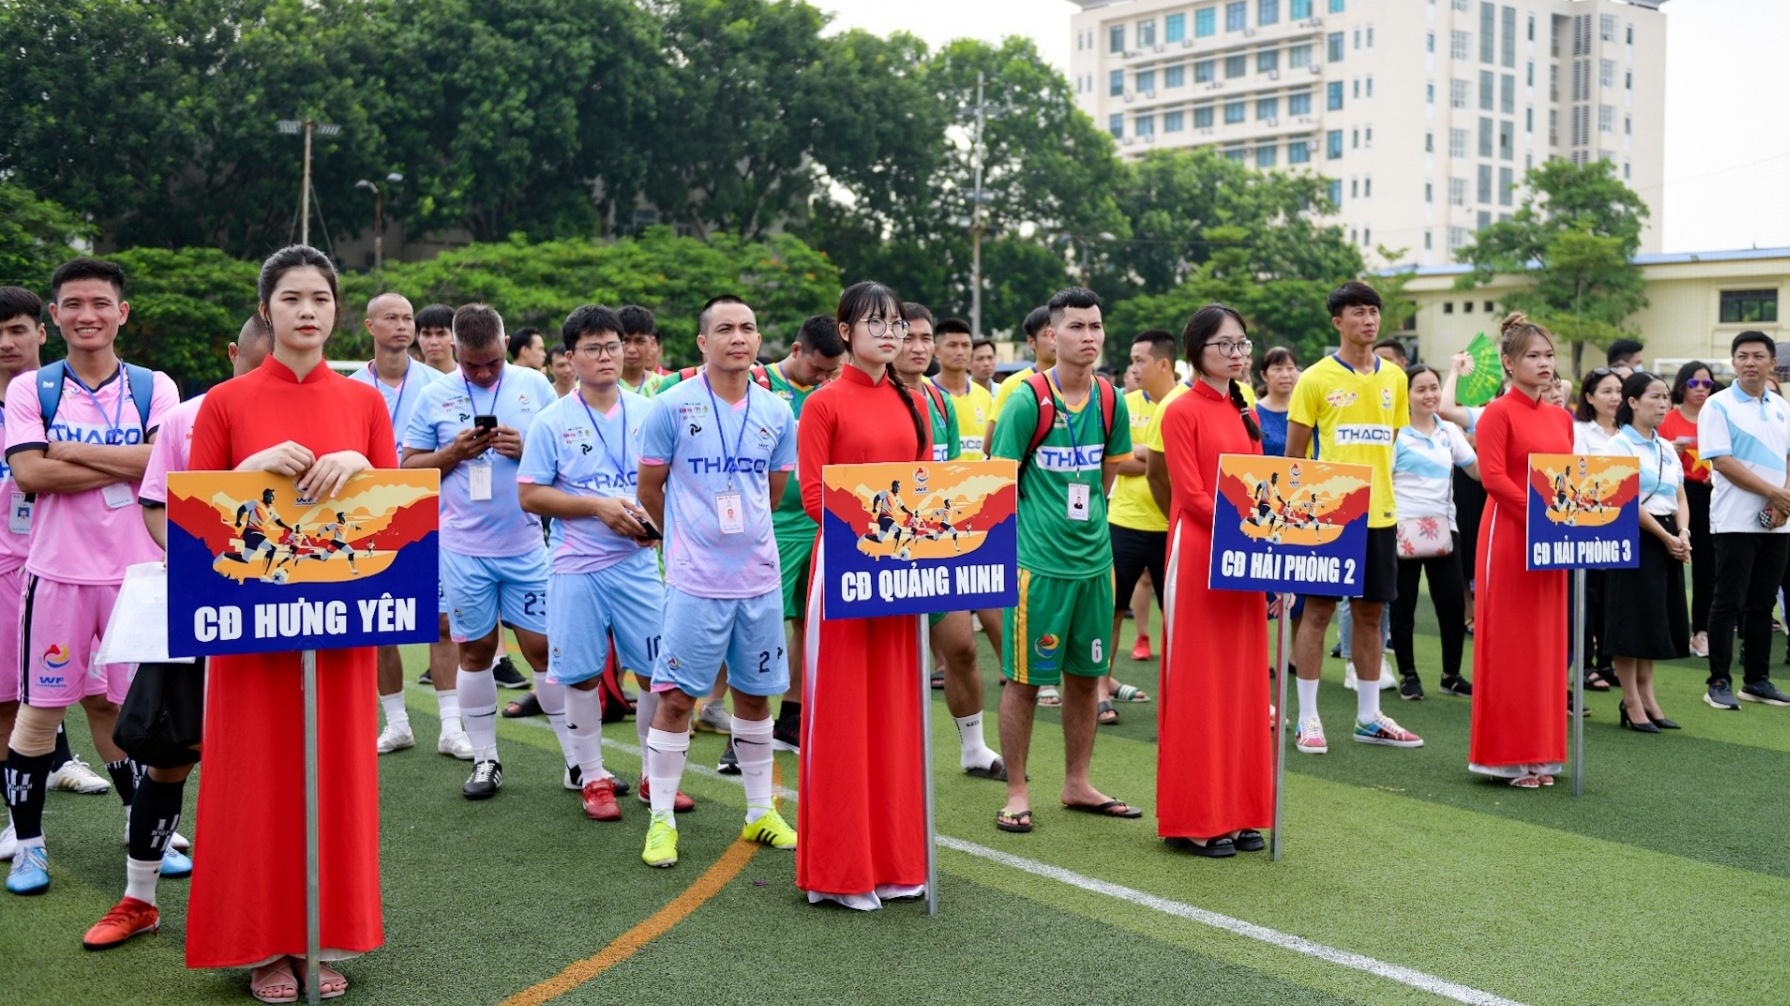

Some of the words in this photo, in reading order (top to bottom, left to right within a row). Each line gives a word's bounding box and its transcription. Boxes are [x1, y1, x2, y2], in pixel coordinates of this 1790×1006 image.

[49, 423, 142, 445] THACO
[1337, 429, 1391, 441] THACO
[687, 456, 767, 475] THACO
[1041, 448, 1103, 467] THAC
[577, 471, 638, 490] THAC
[1533, 542, 1551, 566] CĐ
[1553, 534, 1575, 565] HẢI
[1577, 536, 1620, 564] PHÒNG
[1621, 539, 1632, 562] 3
[1221, 549, 1247, 577] CĐ
[1249, 546, 1282, 580] HẢI
[1283, 550, 1341, 583] PHÒNG
[1343, 558, 1356, 585] 2
[841, 571, 873, 602] CĐ
[878, 562, 950, 602] QUẢNG
[955, 564, 1005, 595] NINH
[193, 605, 243, 643] CĐ
[254, 597, 348, 639] HƯNG
[356, 592, 417, 633] YÊN
[758, 650, 771, 674] 2
[1091, 638, 1103, 664] 6
[39, 676, 65, 684] WF
